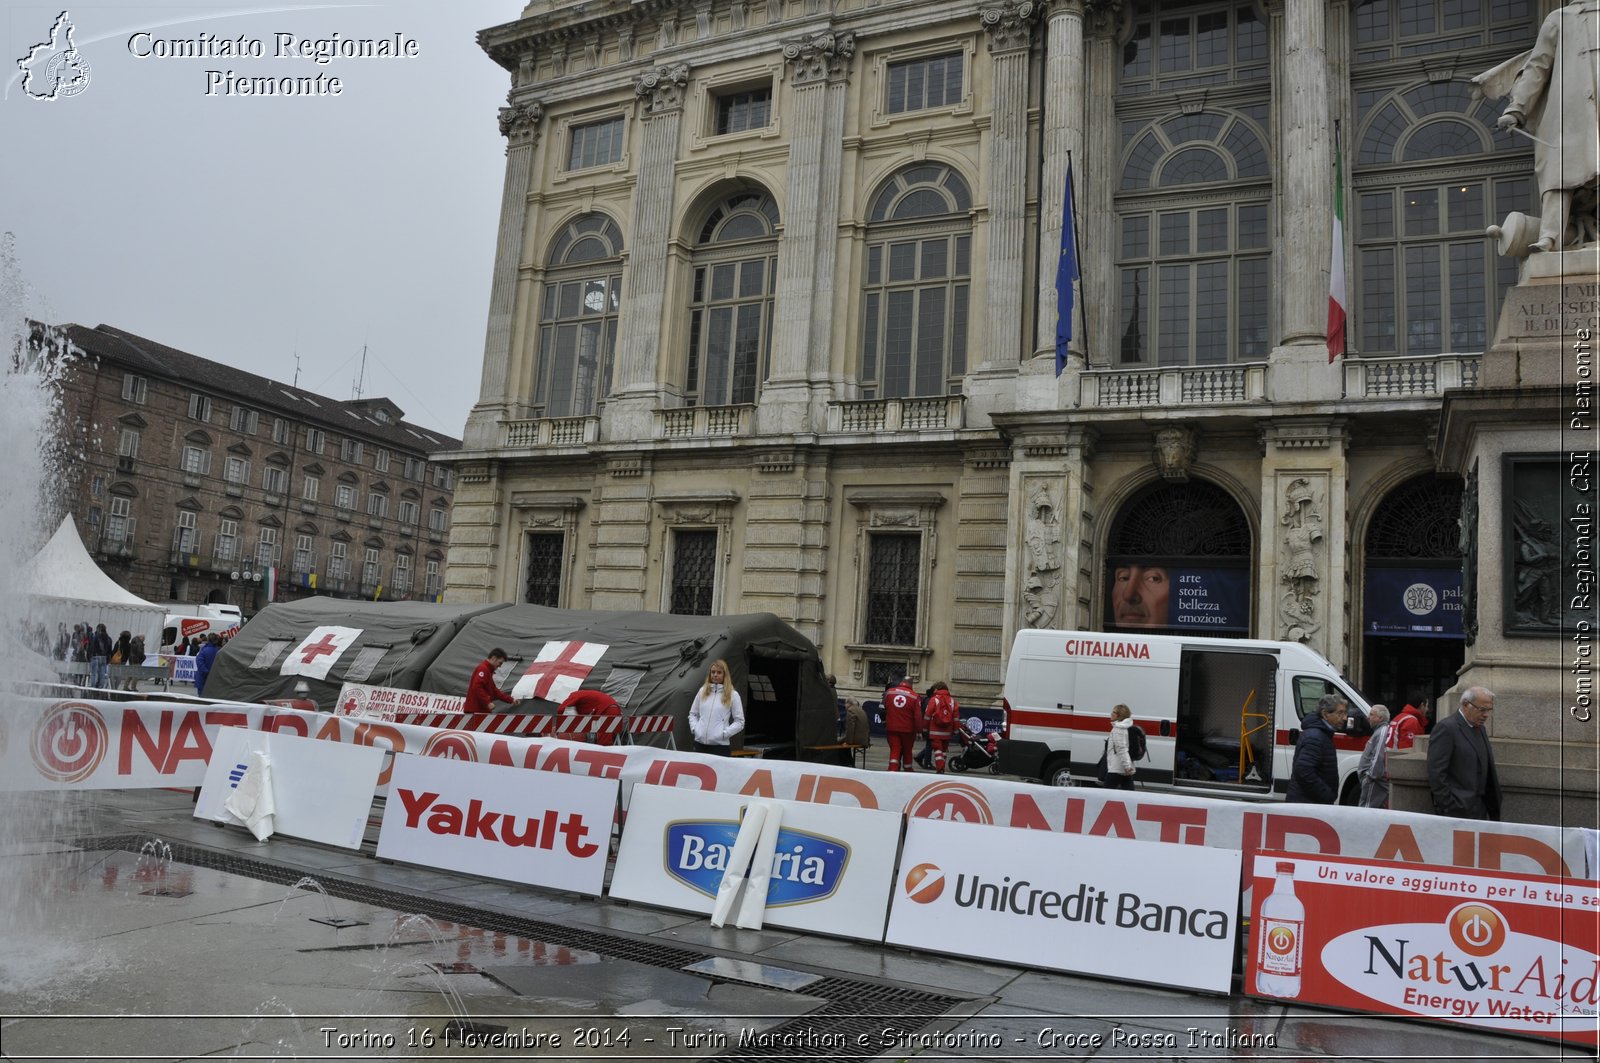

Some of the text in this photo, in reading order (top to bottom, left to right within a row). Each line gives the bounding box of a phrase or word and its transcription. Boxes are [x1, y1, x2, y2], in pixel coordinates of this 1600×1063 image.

[1179, 574, 1201, 584] arte
[1178, 586, 1208, 597] storia
[1178, 600, 1220, 611] bellezza
[1178, 613, 1227, 624] emozione
[176, 659, 194, 669] TURIN
[370, 690, 397, 703] CROCE
[399, 693, 429, 708] ROSSA
[366, 702, 396, 713] COMITATO
[396, 787, 599, 859] Yakult
[679, 834, 824, 886] Baria
[1317, 866, 1338, 881] Un
[1345, 869, 1395, 886] valore
[1402, 873, 1478, 895] aggiunto
[1486, 884, 1516, 902] per
[1523, 885, 1538, 901] la
[1545, 889, 1574, 903] tua
[954, 873, 1229, 940] UniCredit Banca
[1403, 987, 1556, 1025] Energy Water
